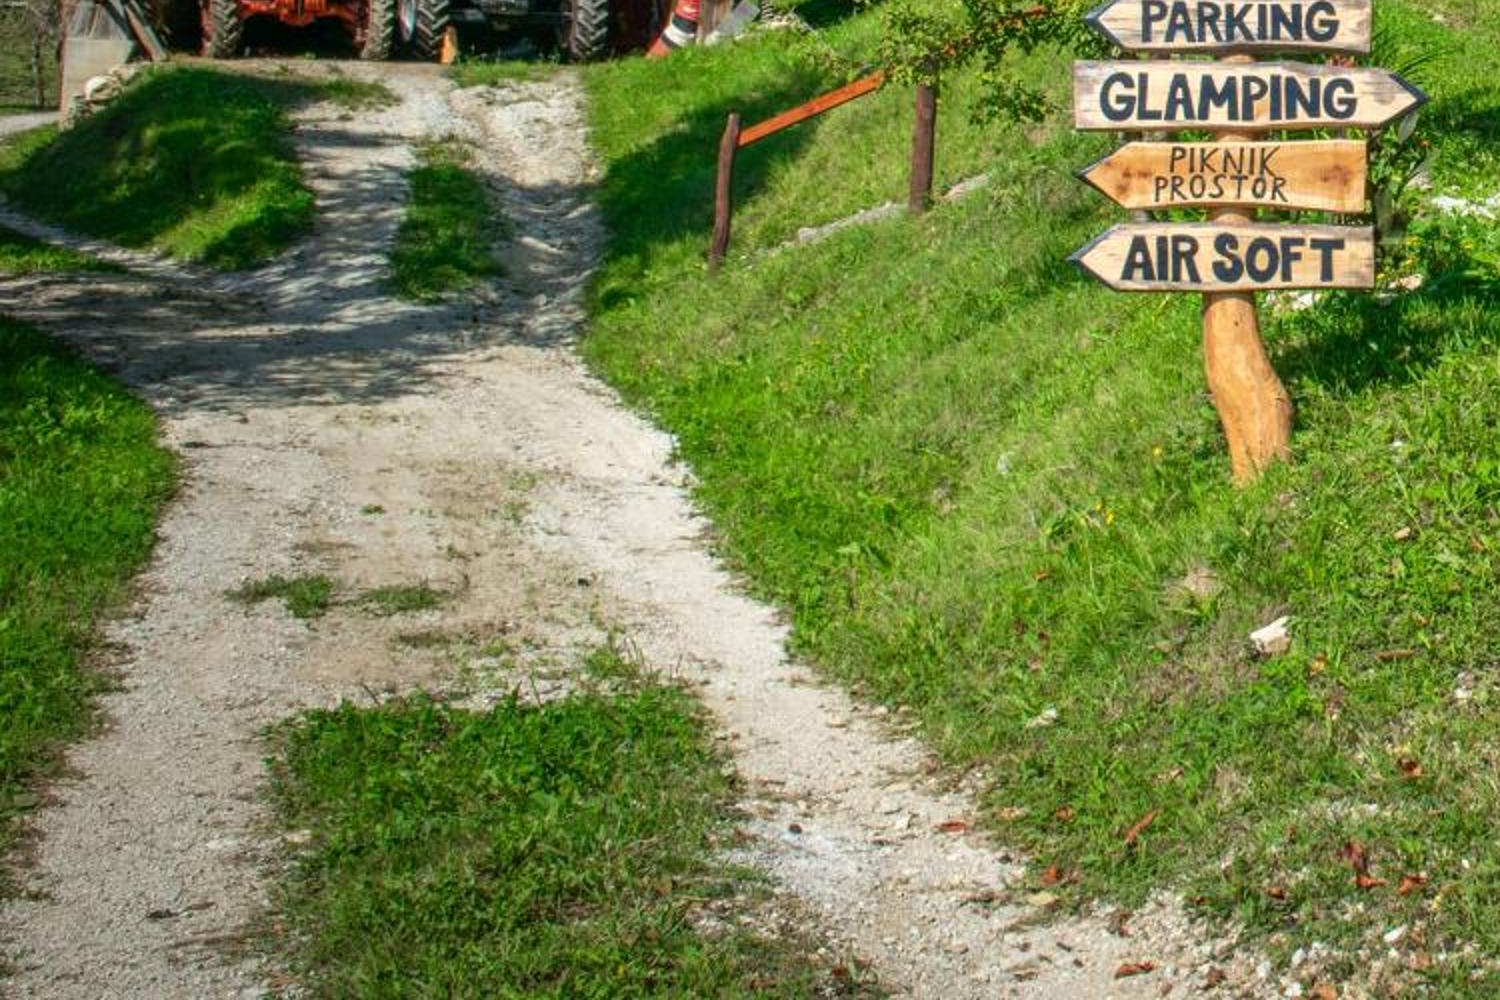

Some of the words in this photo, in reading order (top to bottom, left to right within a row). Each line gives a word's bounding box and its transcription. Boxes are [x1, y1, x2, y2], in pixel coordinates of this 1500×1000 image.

[1141, 0, 1340, 43] PARKING
[1100, 72, 1357, 122] GLAMPING
[1170, 145, 1281, 177] PIKNIK
[1154, 174, 1288, 202] PROSTOR
[1121, 234, 1201, 282] AIR
[1211, 232, 1345, 283] SOFT
